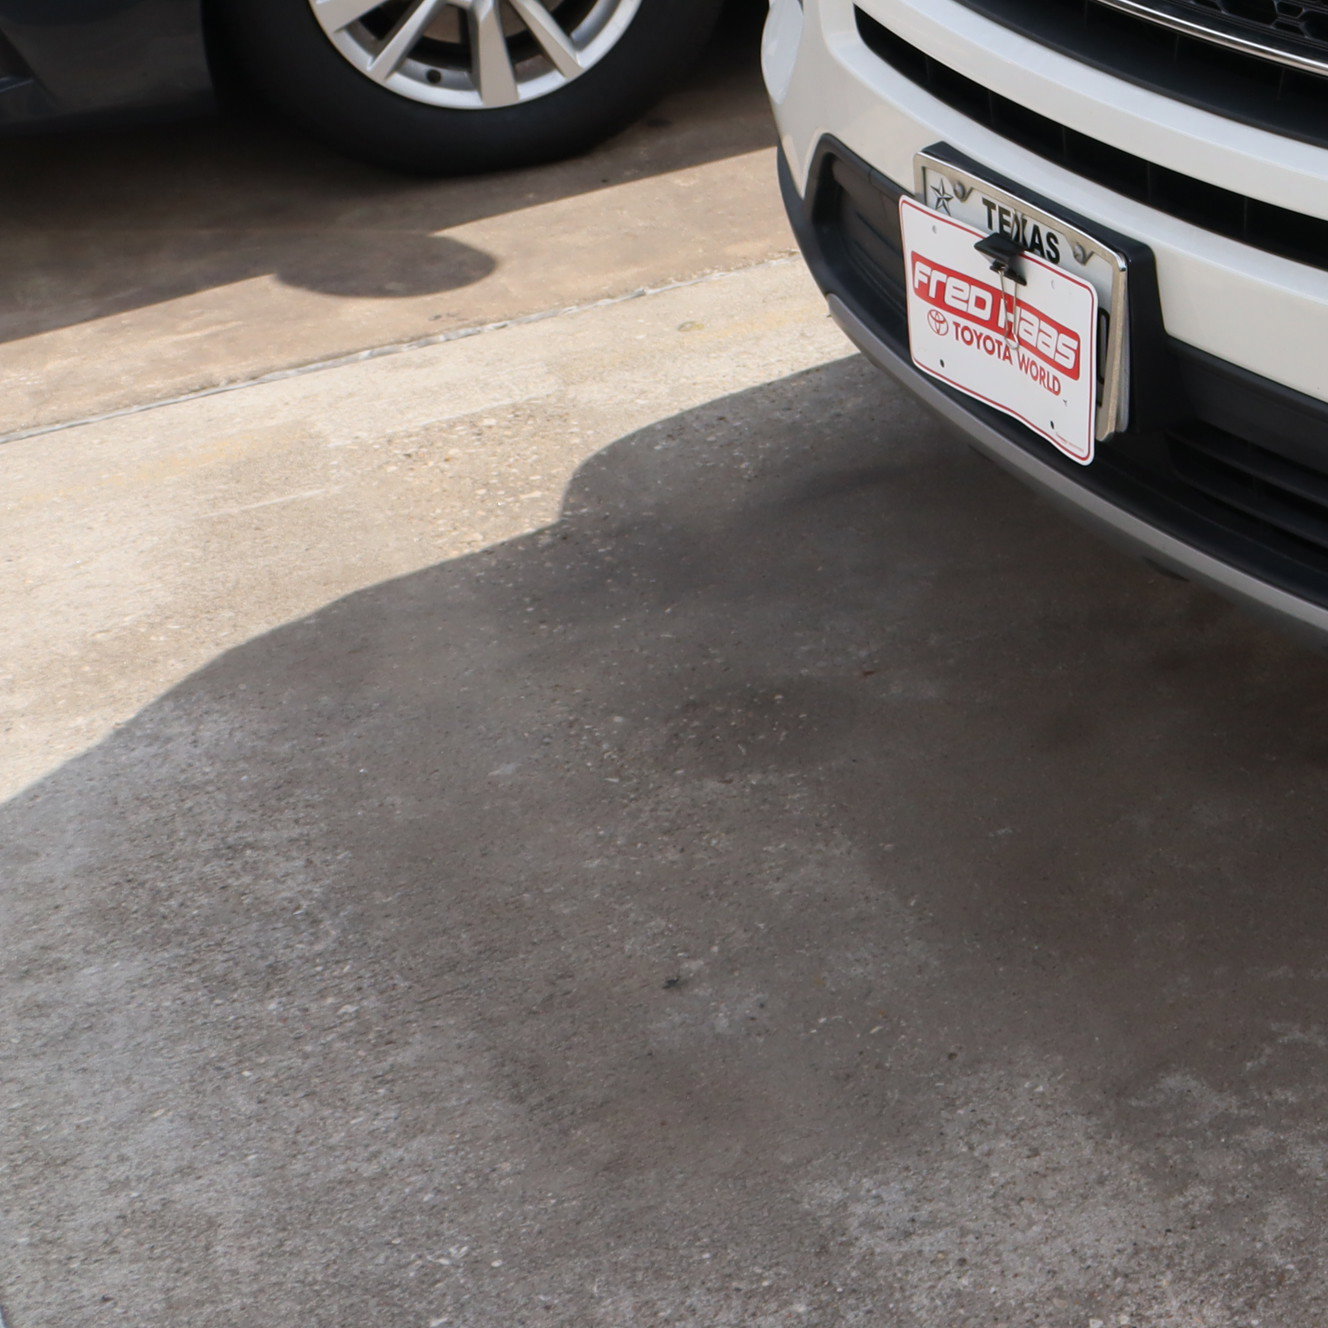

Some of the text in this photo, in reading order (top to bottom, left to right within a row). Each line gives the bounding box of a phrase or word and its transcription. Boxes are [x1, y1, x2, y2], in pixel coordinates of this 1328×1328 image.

[982, 197, 1060, 264] TEXAS
[952, 322, 1062, 397] TOYOTA WORLD
